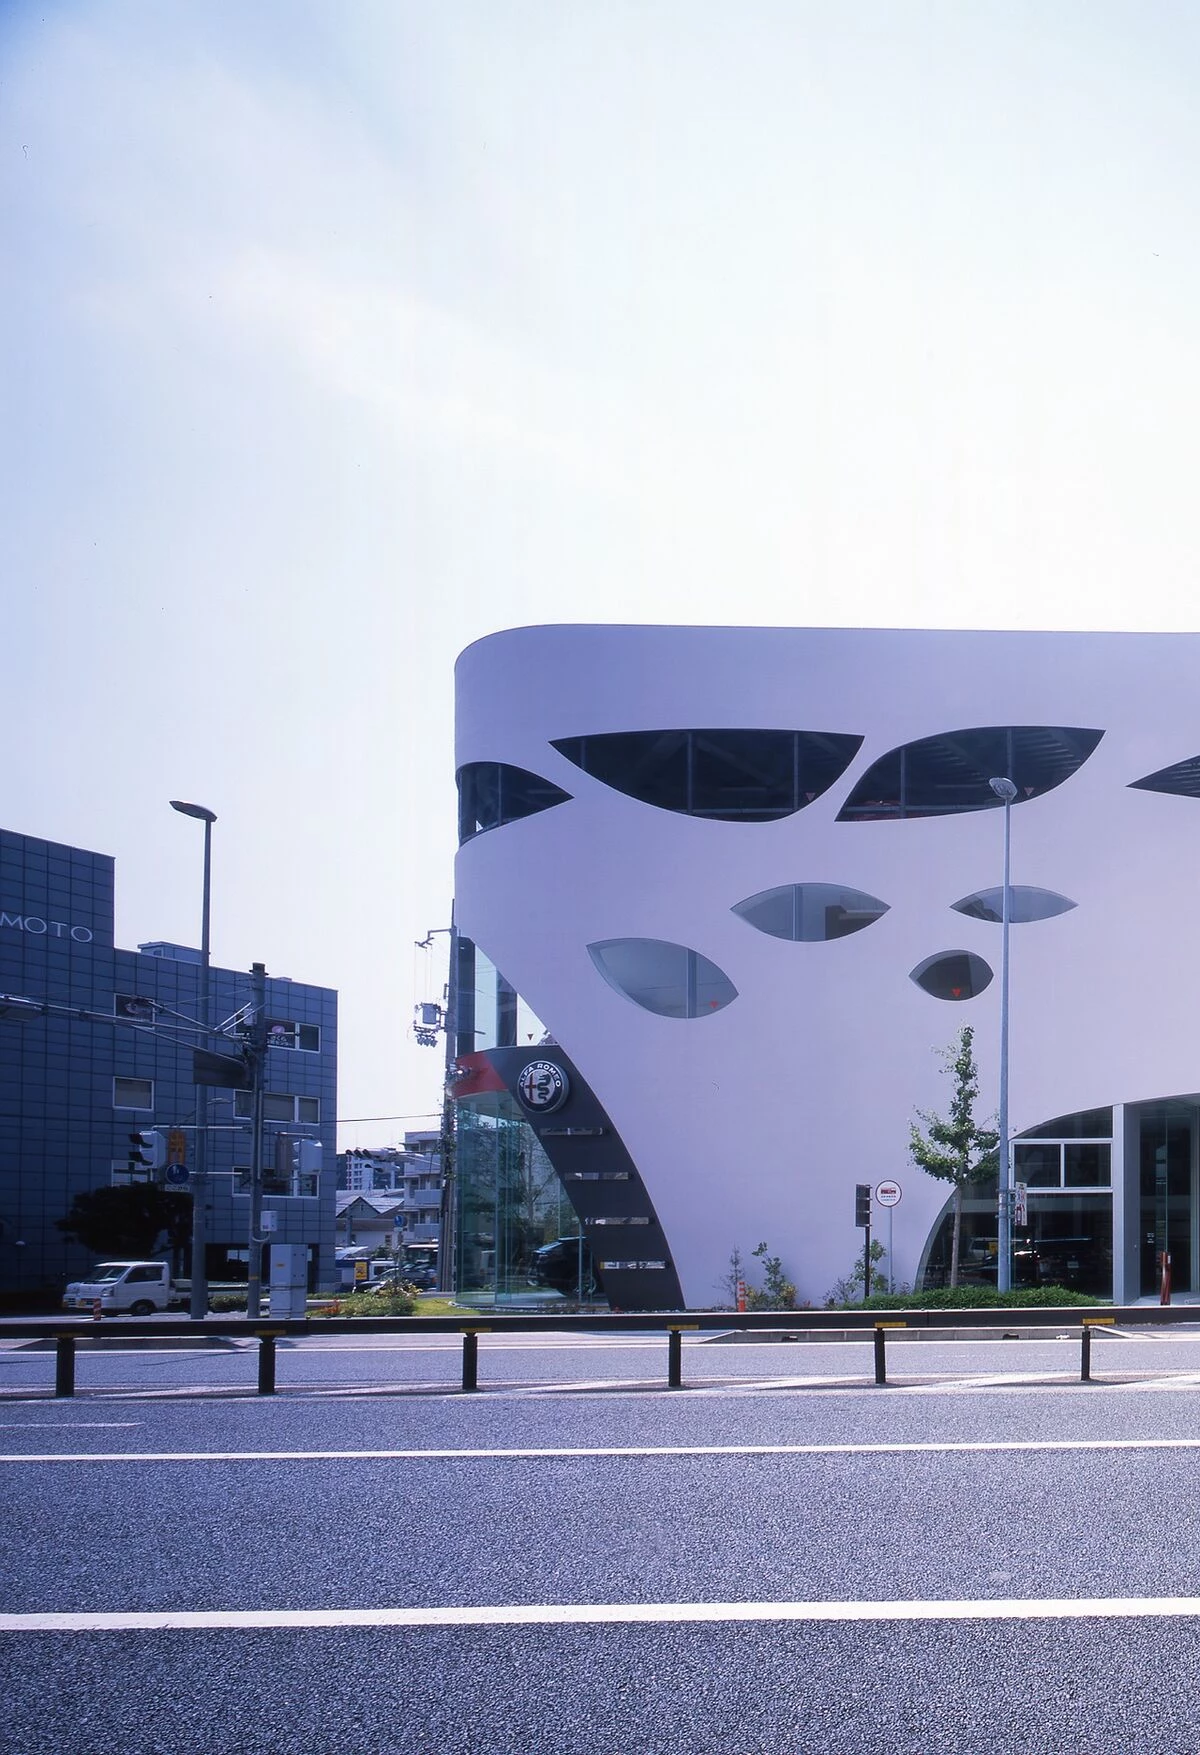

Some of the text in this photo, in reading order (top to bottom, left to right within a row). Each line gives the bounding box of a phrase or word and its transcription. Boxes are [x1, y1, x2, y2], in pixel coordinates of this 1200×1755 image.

[0, 911, 93, 943] MOTO
[519, 1063, 562, 1088] ALFA ROMEO
